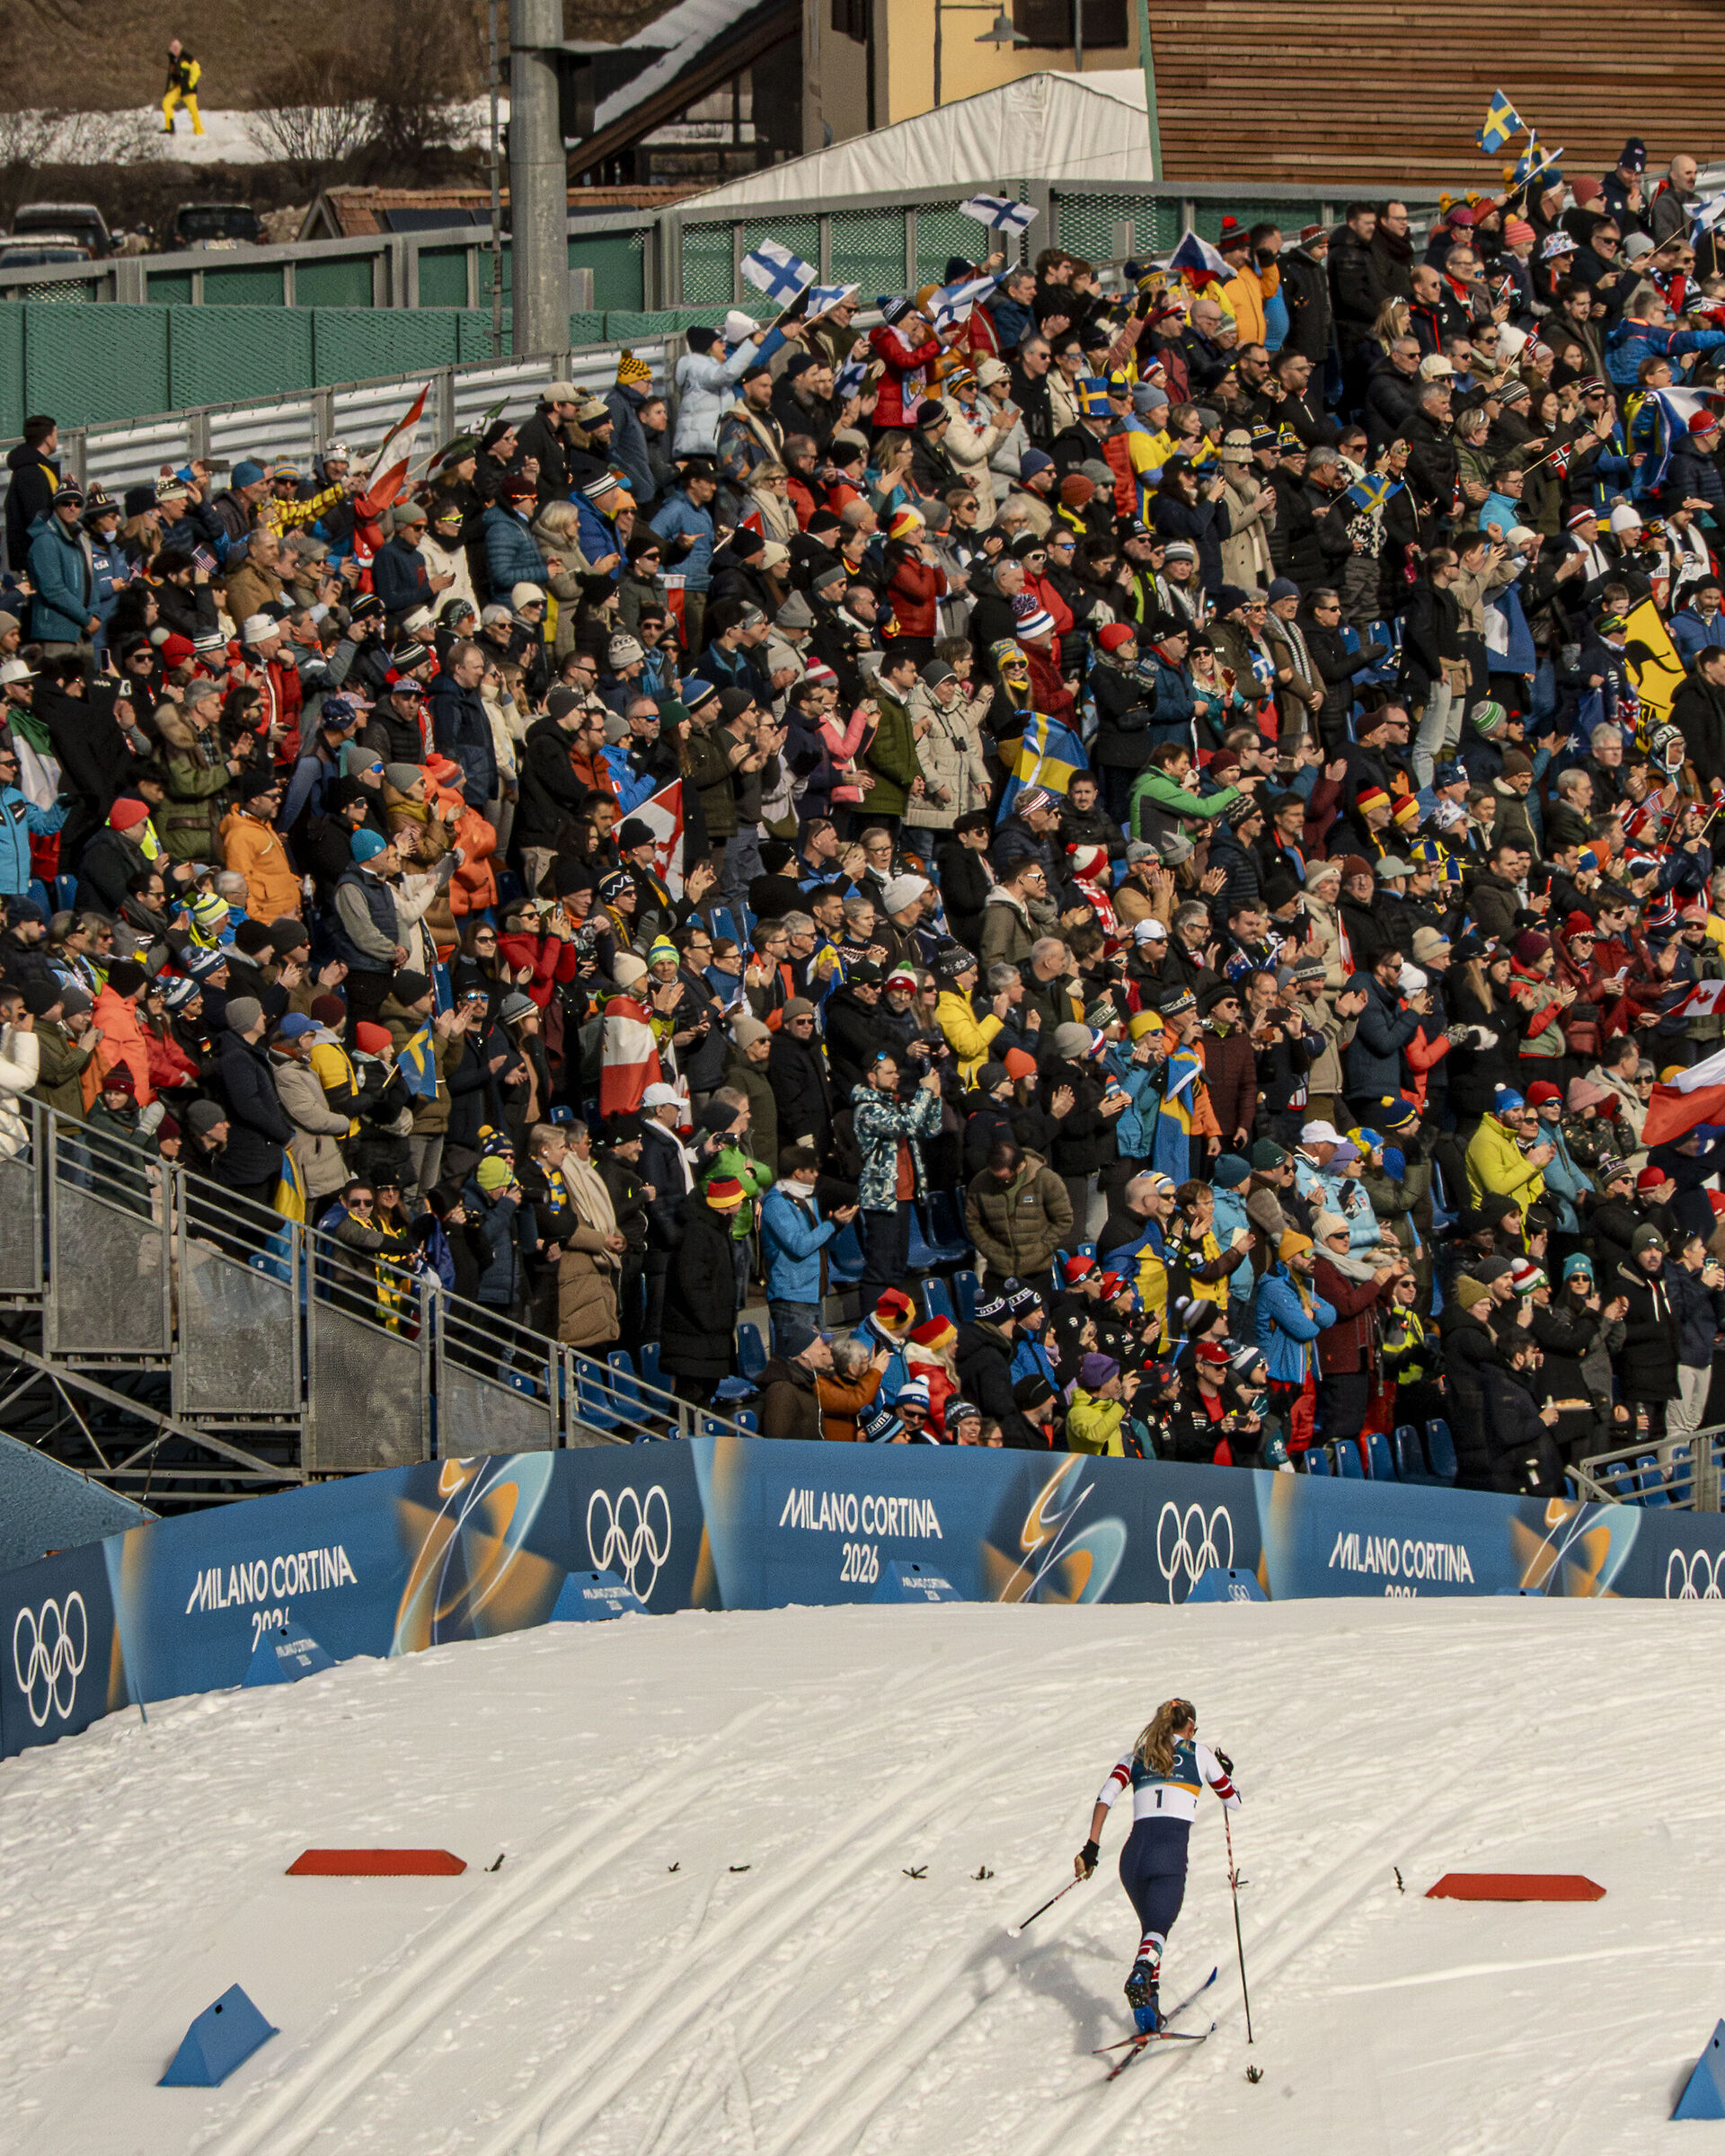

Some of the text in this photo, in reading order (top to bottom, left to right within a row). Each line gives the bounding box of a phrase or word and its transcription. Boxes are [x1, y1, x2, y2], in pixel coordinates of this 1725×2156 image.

[779, 1488, 942, 1539] MILANO CORTINA
[185, 1545, 358, 1614] MILANO CORTINA
[840, 1542, 880, 1584] 2026
[1328, 1531, 1475, 1584] MILANO CORTINA
[1154, 1789, 1163, 1808] 1
